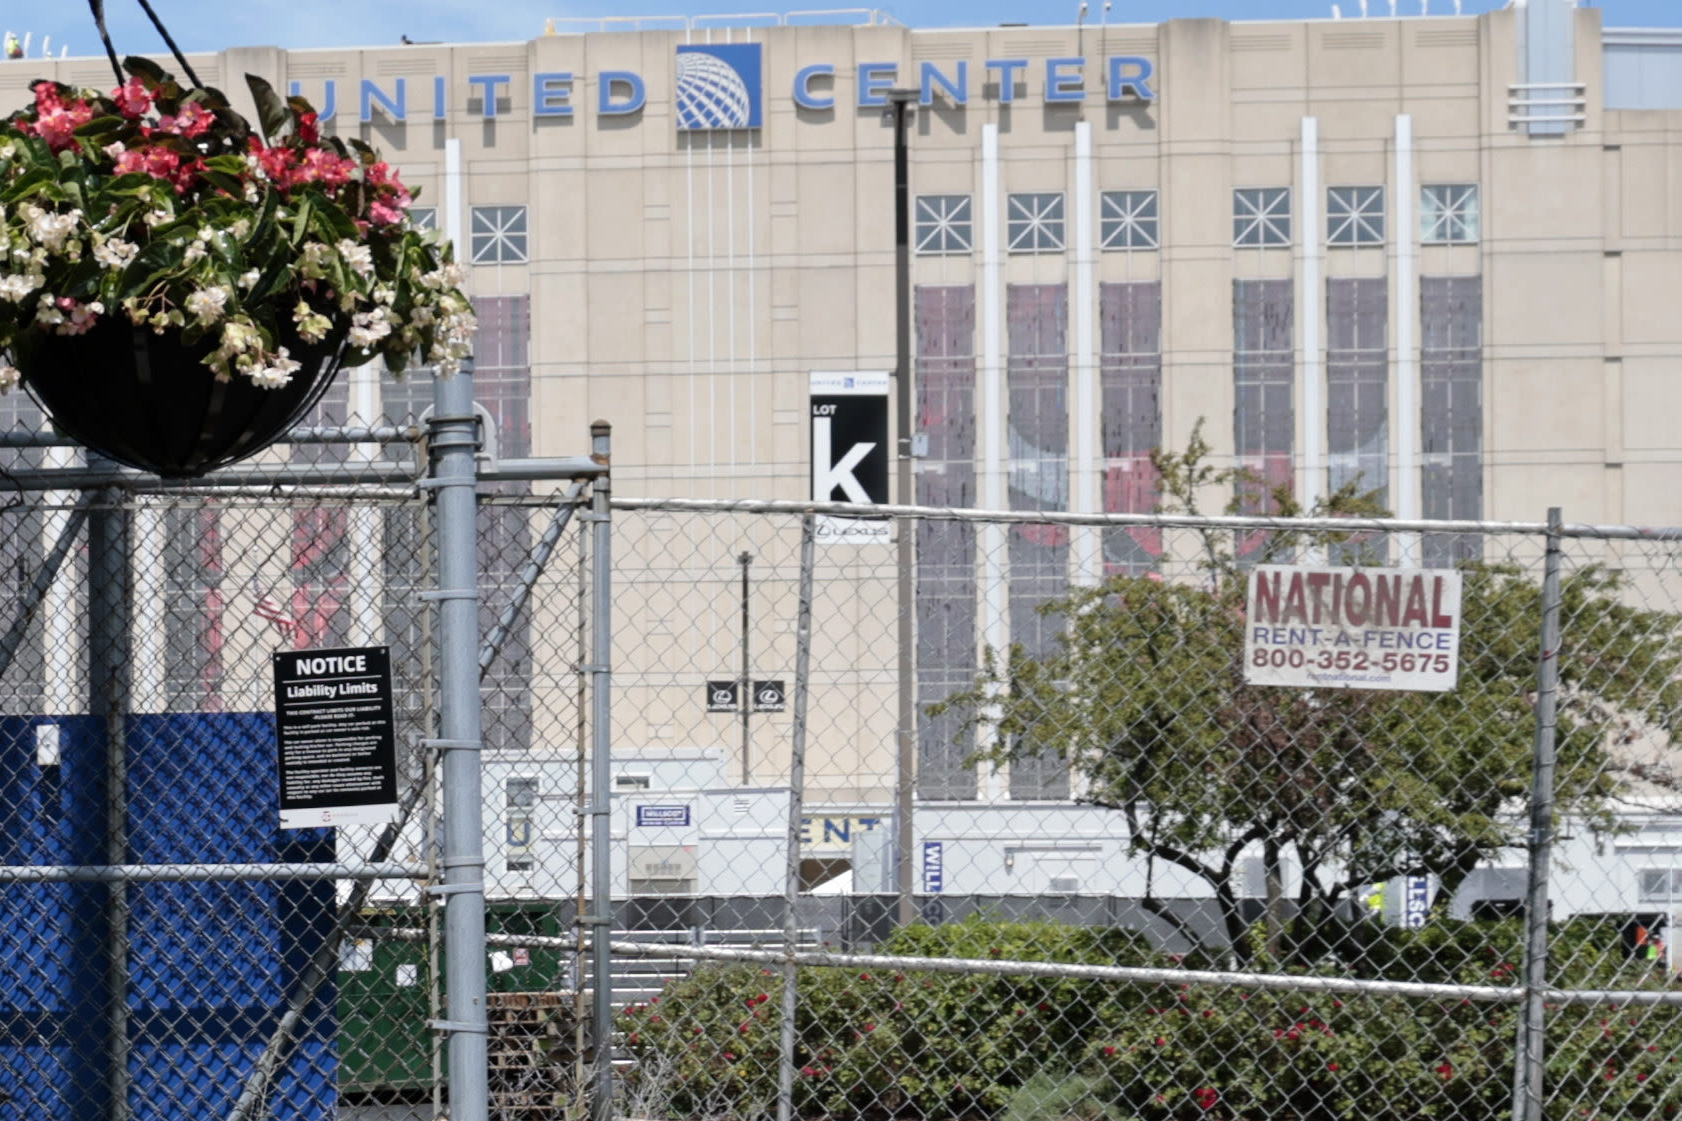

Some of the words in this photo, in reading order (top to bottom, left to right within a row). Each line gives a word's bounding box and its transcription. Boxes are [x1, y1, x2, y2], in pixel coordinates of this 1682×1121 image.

[290, 70, 648, 124] UNITED
[792, 56, 1157, 110] CENTER
[812, 404, 837, 416] LOT
[832, 526, 889, 536] LEXUS
[1254, 570, 1452, 629] NATIONAL
[1252, 626, 1451, 650] RENT-A-FENCE
[295, 654, 367, 676] NOTICE
[1252, 648, 1450, 673] 800-352-5675
[286, 684, 338, 699] Liability
[338, 681, 378, 696] Limits
